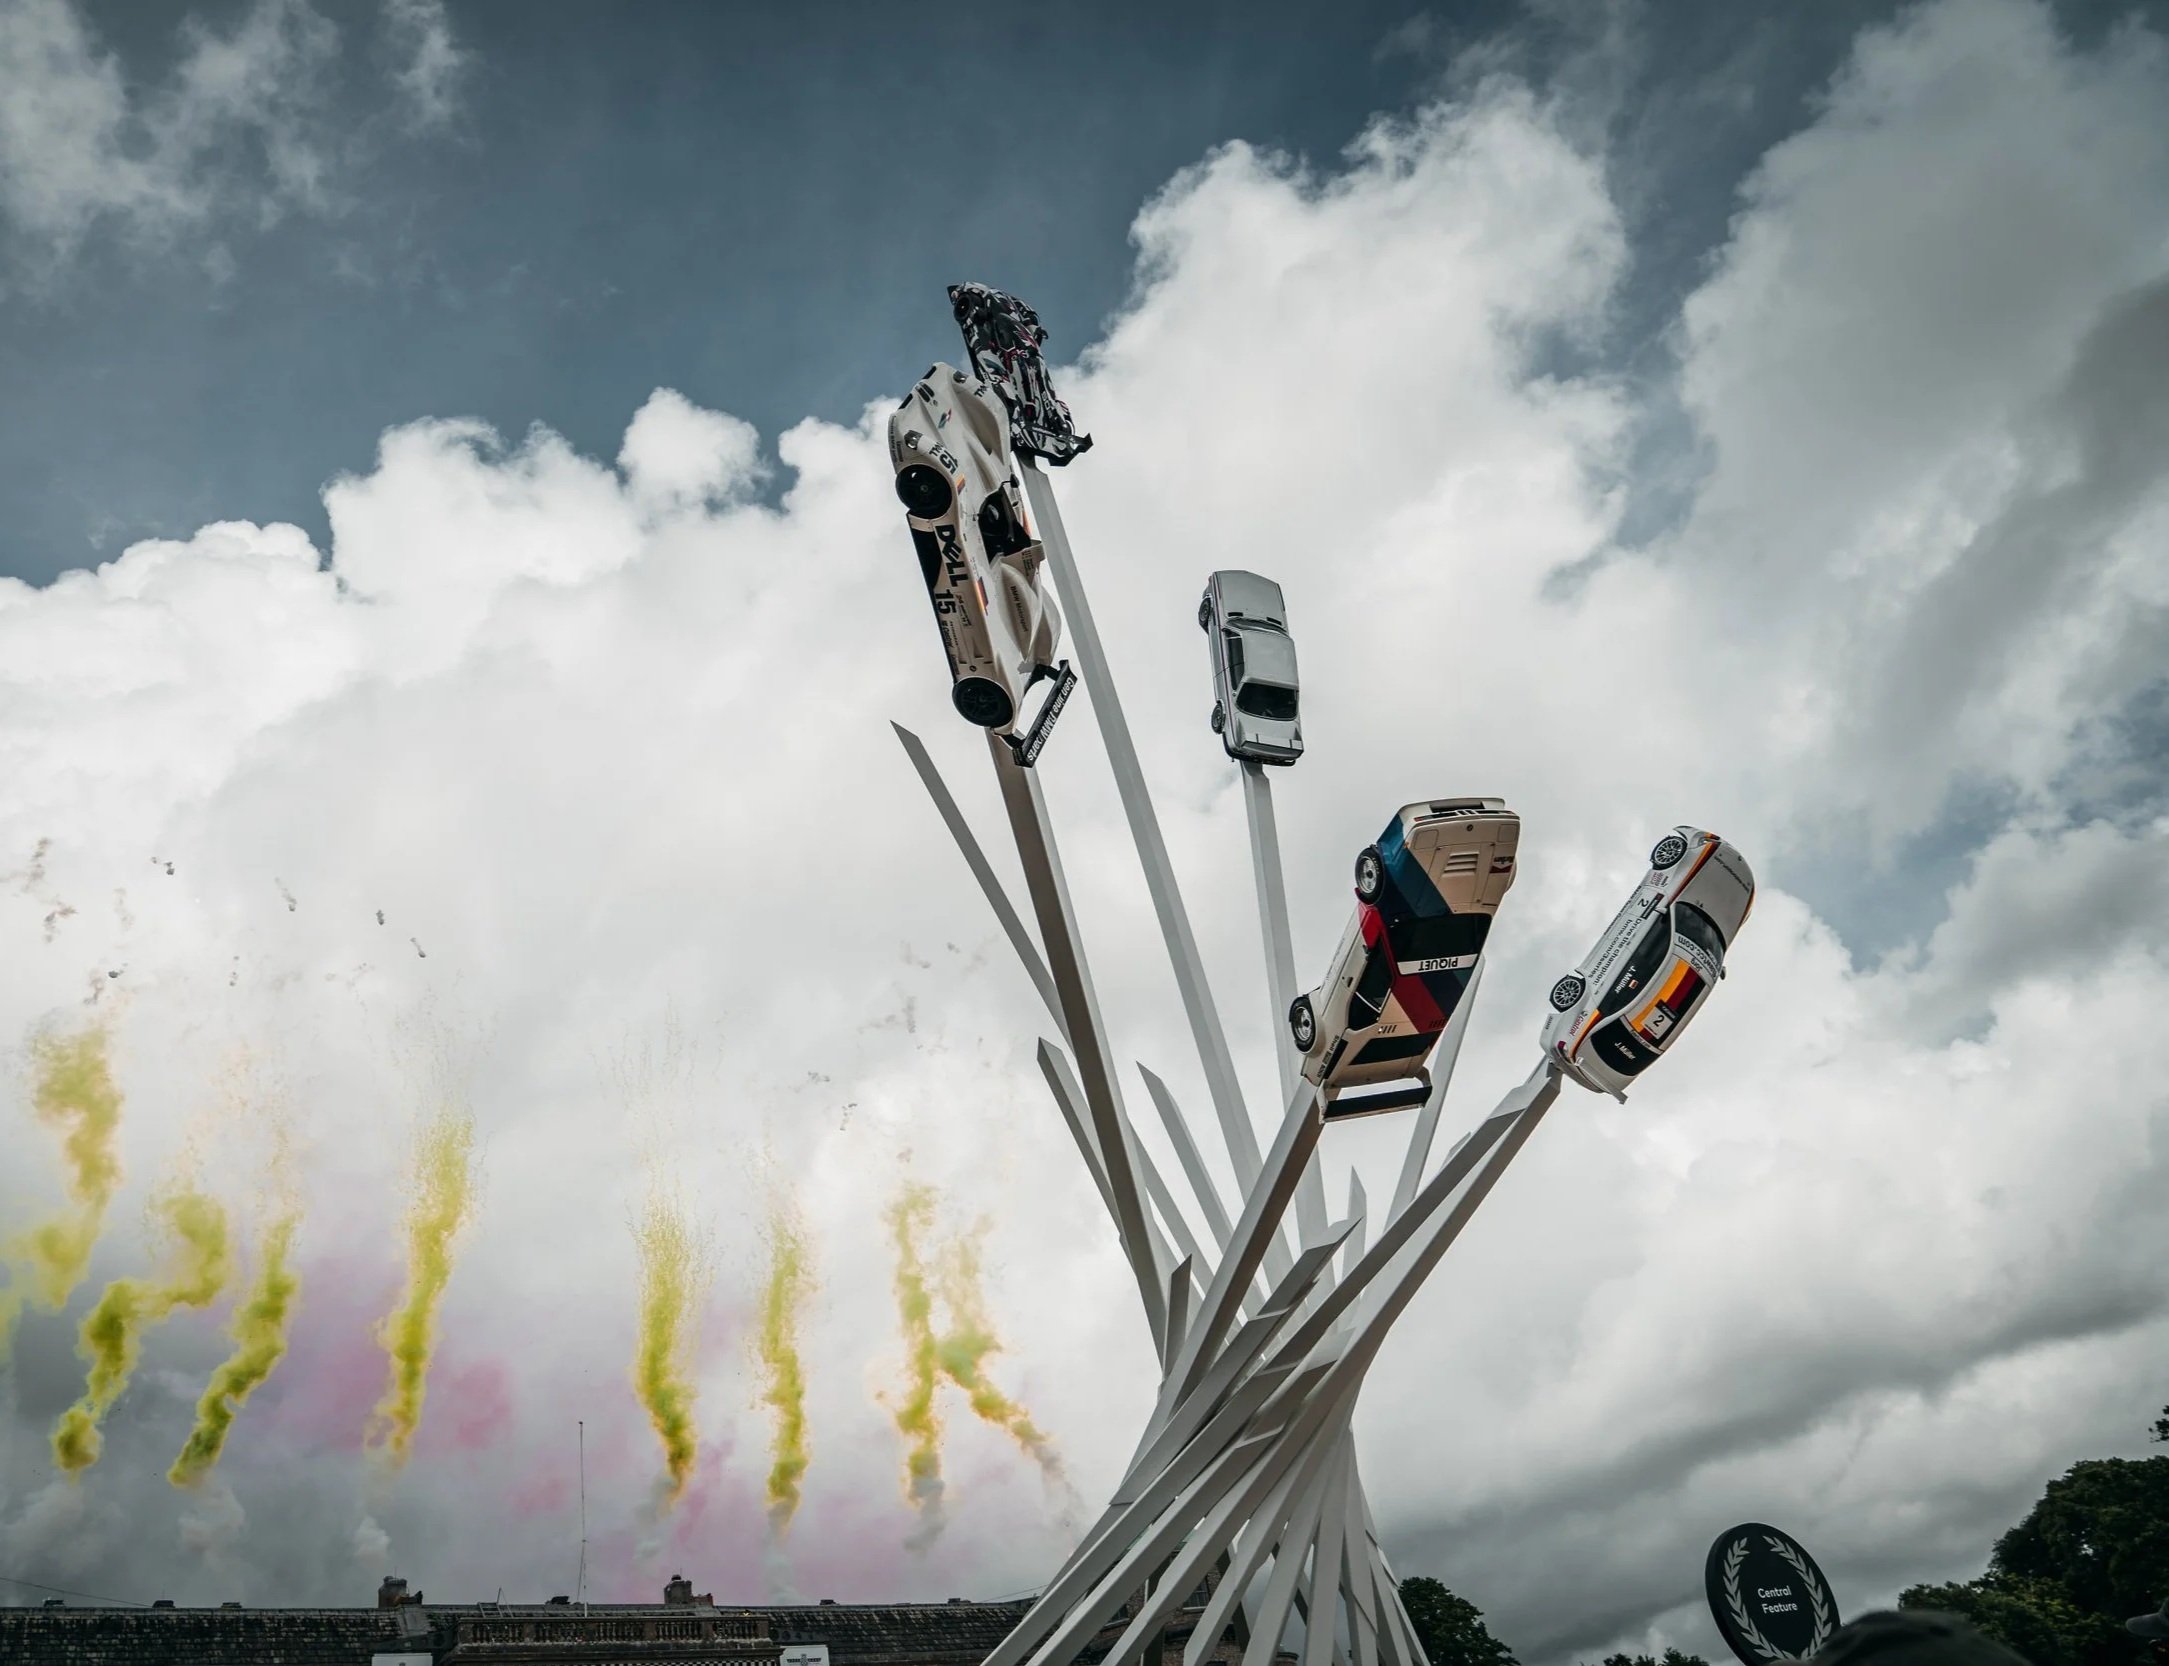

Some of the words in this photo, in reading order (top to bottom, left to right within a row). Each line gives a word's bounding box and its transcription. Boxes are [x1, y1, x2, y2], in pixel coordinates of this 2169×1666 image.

[940, 450, 958, 475] 15
[935, 524, 968, 587] DELL
[935, 589, 956, 614] 15
[1010, 585, 1019, 602] BMW
[1638, 899, 1649, 907] 2
[1625, 917, 1642, 937] Drive
[1588, 919, 1632, 978] bmw.com/3series
[1616, 935, 1629, 949] the
[1418, 957, 1458, 971] PIQUET
[1593, 948, 1619, 985] champion:
[1615, 973, 1632, 994] Müller
[1569, 1015, 1584, 1036] Castrol
[1653, 1014, 1665, 1027] 2
[1757, 1585, 1792, 1599] Central
[1761, 1602, 1798, 1615] Feature
